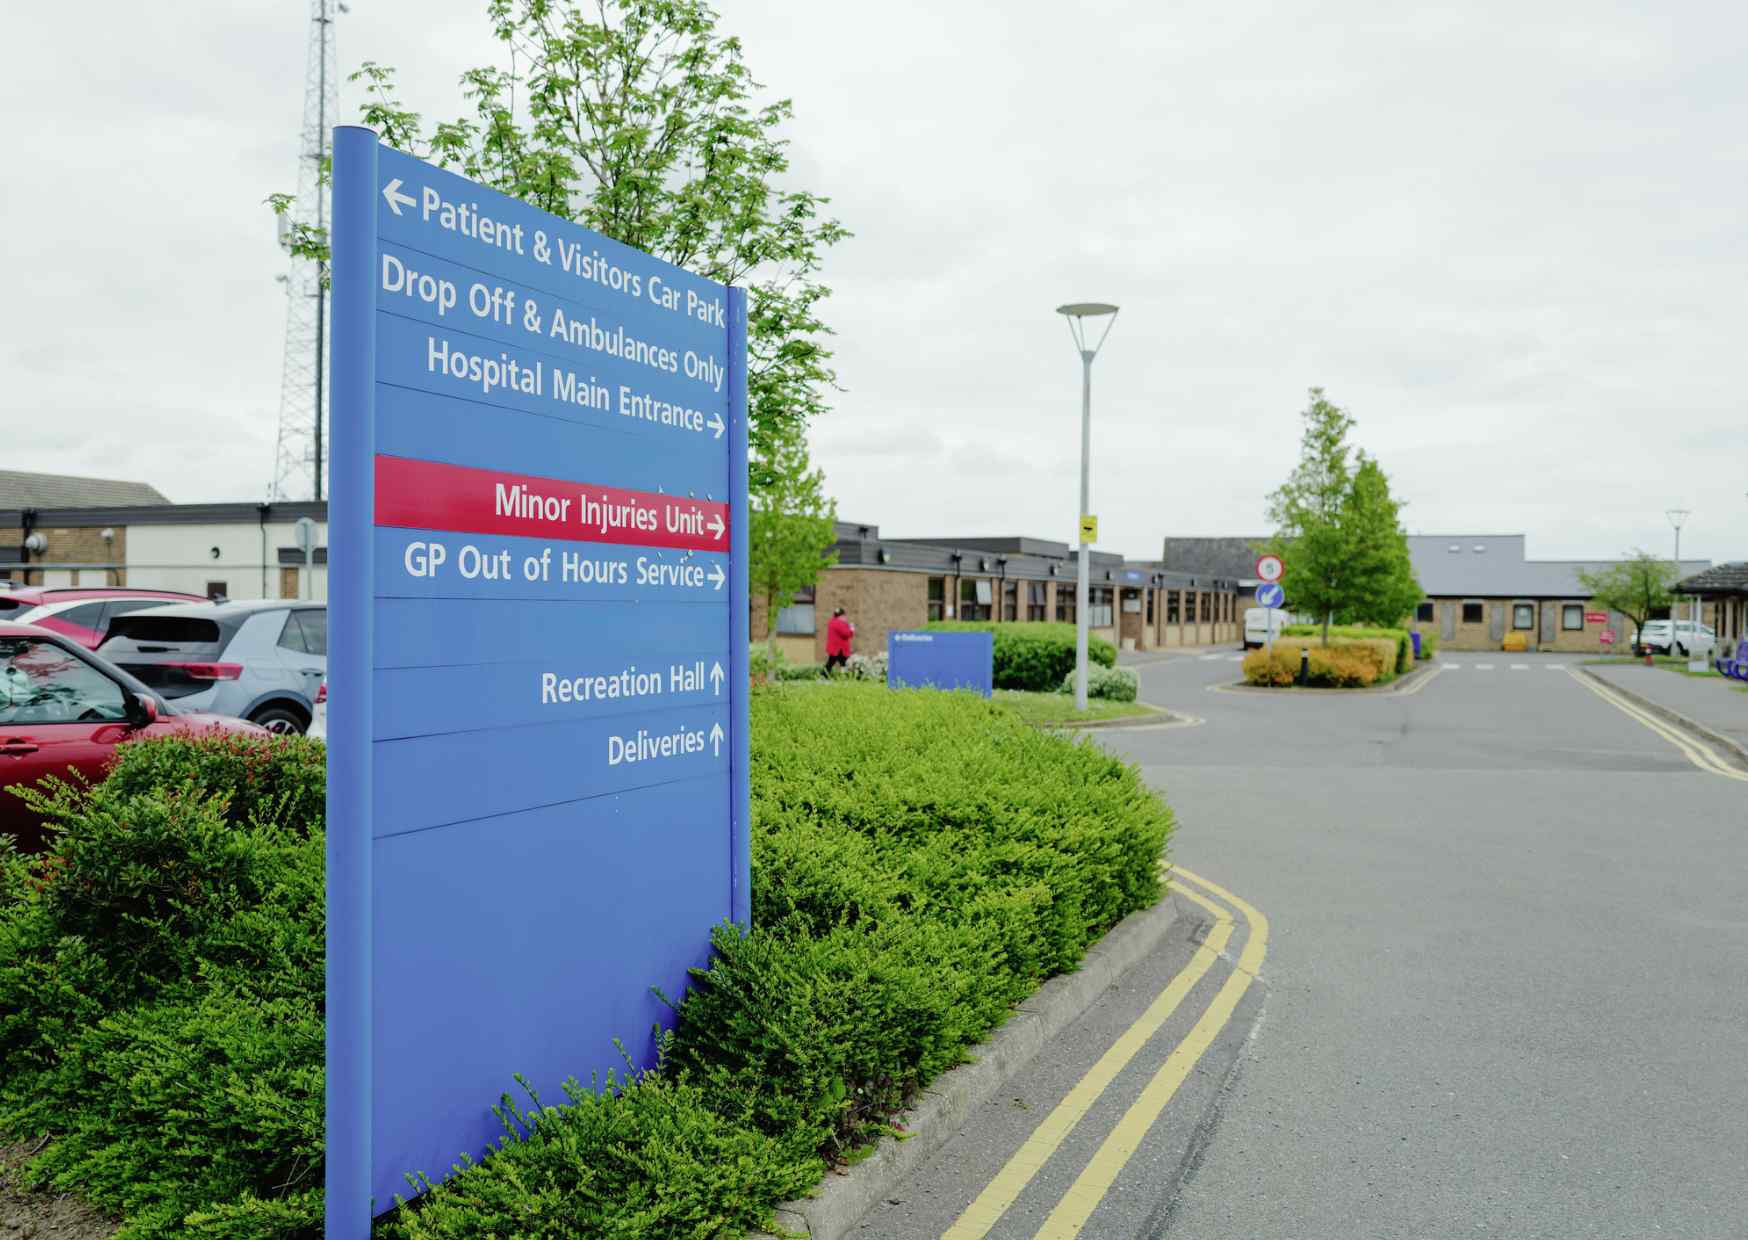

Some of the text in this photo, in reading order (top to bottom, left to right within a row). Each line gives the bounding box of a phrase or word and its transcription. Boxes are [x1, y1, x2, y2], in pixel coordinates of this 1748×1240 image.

[423, 186, 726, 329] Patient & Visitors Car Park
[382, 254, 724, 393] Drop Off & Ambulances Only
[428, 336, 704, 433] Hospital Main Entrance
[495, 483, 705, 536] Minor Injuries Unit
[404, 541, 705, 588] GP Out of Hours Service
[542, 661, 705, 704] Recreation Hall
[608, 724, 705, 765] Deliveries
